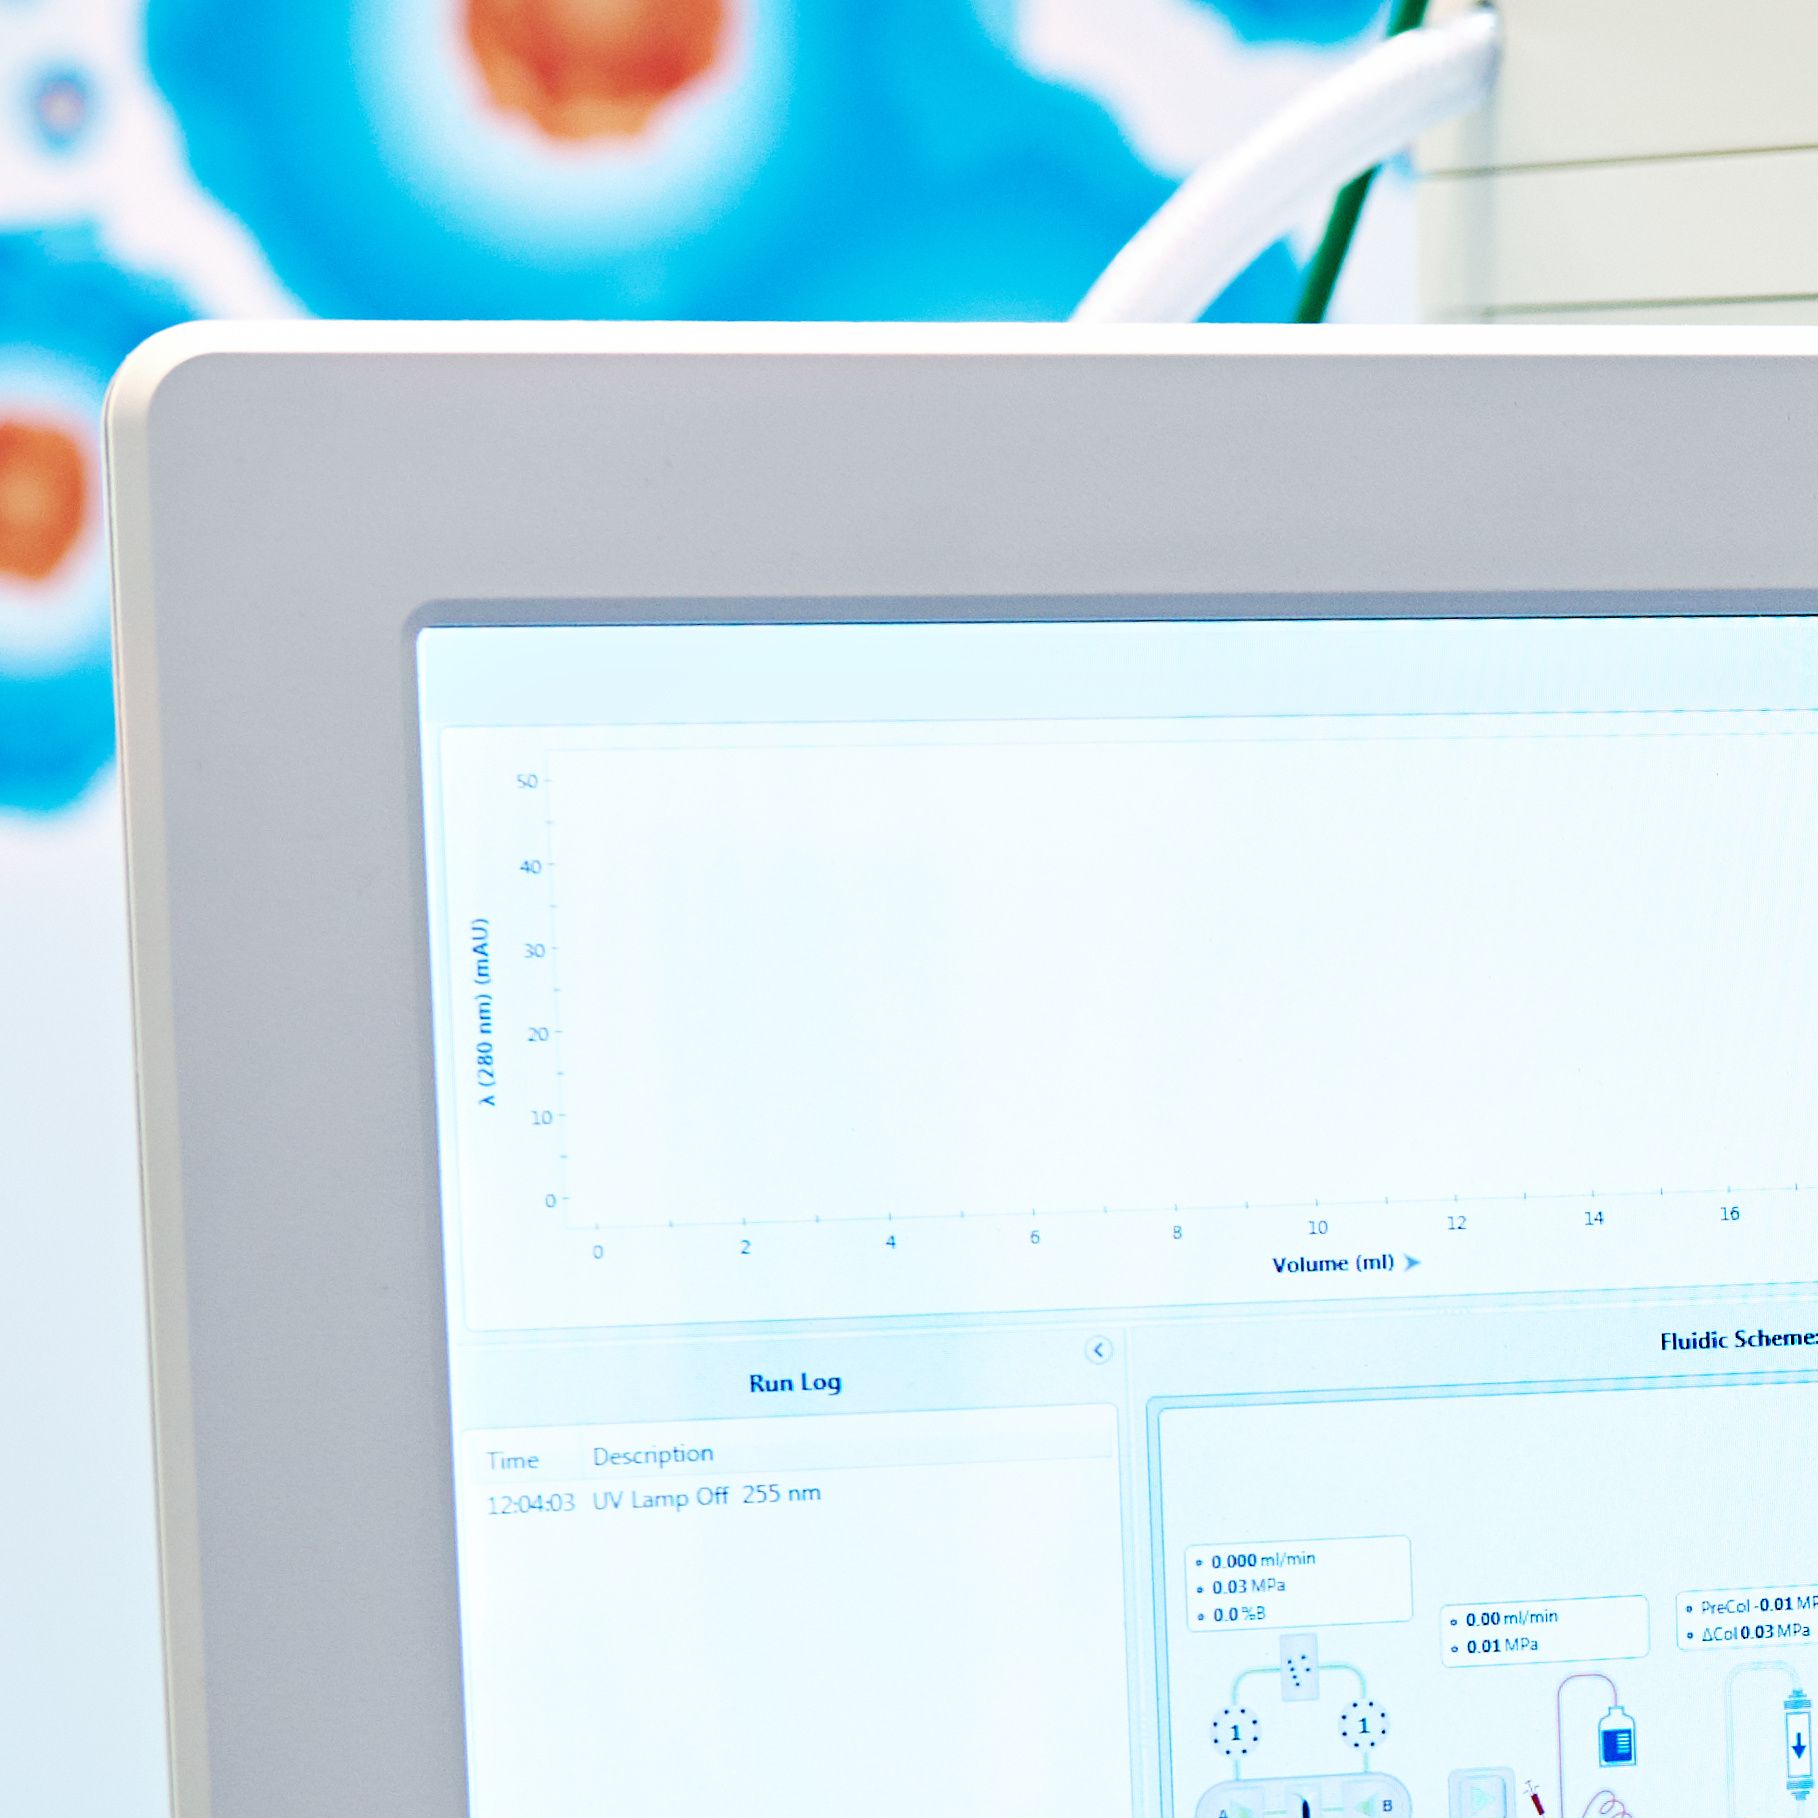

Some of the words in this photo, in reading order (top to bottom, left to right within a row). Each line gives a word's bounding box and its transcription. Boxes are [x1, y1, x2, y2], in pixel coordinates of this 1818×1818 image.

[516, 773, 538, 789] 50
[519, 860, 542, 875] 40
[472, 918, 490, 985] (mAU)
[523, 943, 546, 959] 30
[474, 993, 493, 1036] nm)
[527, 1027, 550, 1043] 20
[477, 1041, 495, 1087] (280
[530, 1111, 553, 1126] 10
[545, 1193, 557, 1209] 0
[1584, 1211, 1604, 1227] 14
[1720, 1206, 1740, 1222] 16
[1308, 1219, 1329, 1236] 10
[1447, 1215, 1467, 1231] 12
[1030, 1229, 1041, 1245] 6
[1172, 1225, 1183, 1240] 8
[740, 1240, 752, 1255] 2
[885, 1234, 897, 1250] 4
[592, 1244, 604, 1260] 0
[1273, 1254, 1350, 1274] Volume
[1355, 1252, 1395, 1275] (ml)
[1660, 1330, 1729, 1352] Fluidic
[749, 1373, 794, 1394] Run
[801, 1372, 842, 1395] Log
[487, 1451, 539, 1470] Time
[593, 1444, 714, 1467] Description
[488, 1493, 576, 1515] 12:04:03
[592, 1490, 624, 1510] UV
[631, 1488, 689, 1512] Lamp
[696, 1485, 729, 1507] Off
[743, 1484, 781, 1503] 255
[787, 1484, 821, 1502] nm
[1211, 1553, 1257, 1570] 0.000
[1260, 1551, 1316, 1568] ml/min
[1212, 1578, 1247, 1595] 0.03
[1251, 1577, 1286, 1593] MPa
[1213, 1606, 1239, 1622] 0.0
[1701, 1599, 1750, 1615] PreCol
[1466, 1611, 1500, 1628] 0.00
[1503, 1609, 1559, 1626] ml/min
[1740, 1624, 1775, 1640] 0.03
[1777, 1622, 1811, 1639] MPa
[1466, 1638, 1501, 1654] 0.01
[1504, 1637, 1539, 1653] MPa
[1230, 1725, 1241, 1741] 1
[1358, 1718, 1369, 1734] 1
